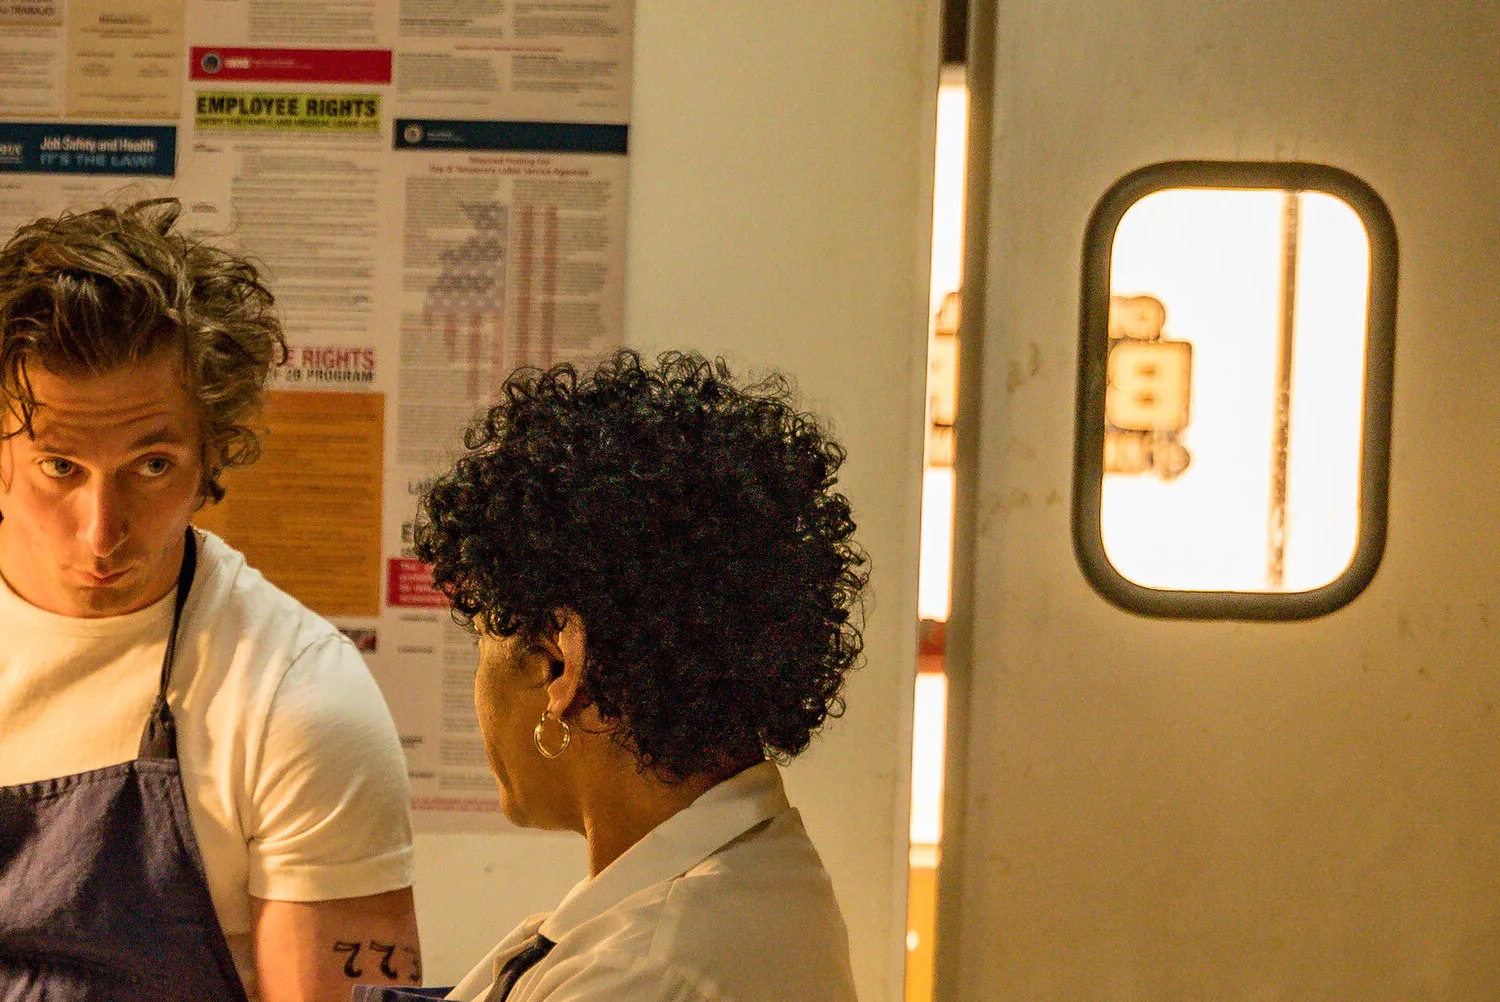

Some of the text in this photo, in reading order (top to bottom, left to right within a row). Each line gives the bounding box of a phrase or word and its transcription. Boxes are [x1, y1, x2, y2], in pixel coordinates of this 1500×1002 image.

[196, 96, 299, 116] EMPLOYEE
[306, 98, 377, 117] RIGHTS
[40, 136, 157, 153] Job Safety and Health
[76, 153, 105, 166] THE
[302, 348, 374, 369] RIGHTS
[307, 370, 374, 383] PROGRAM
